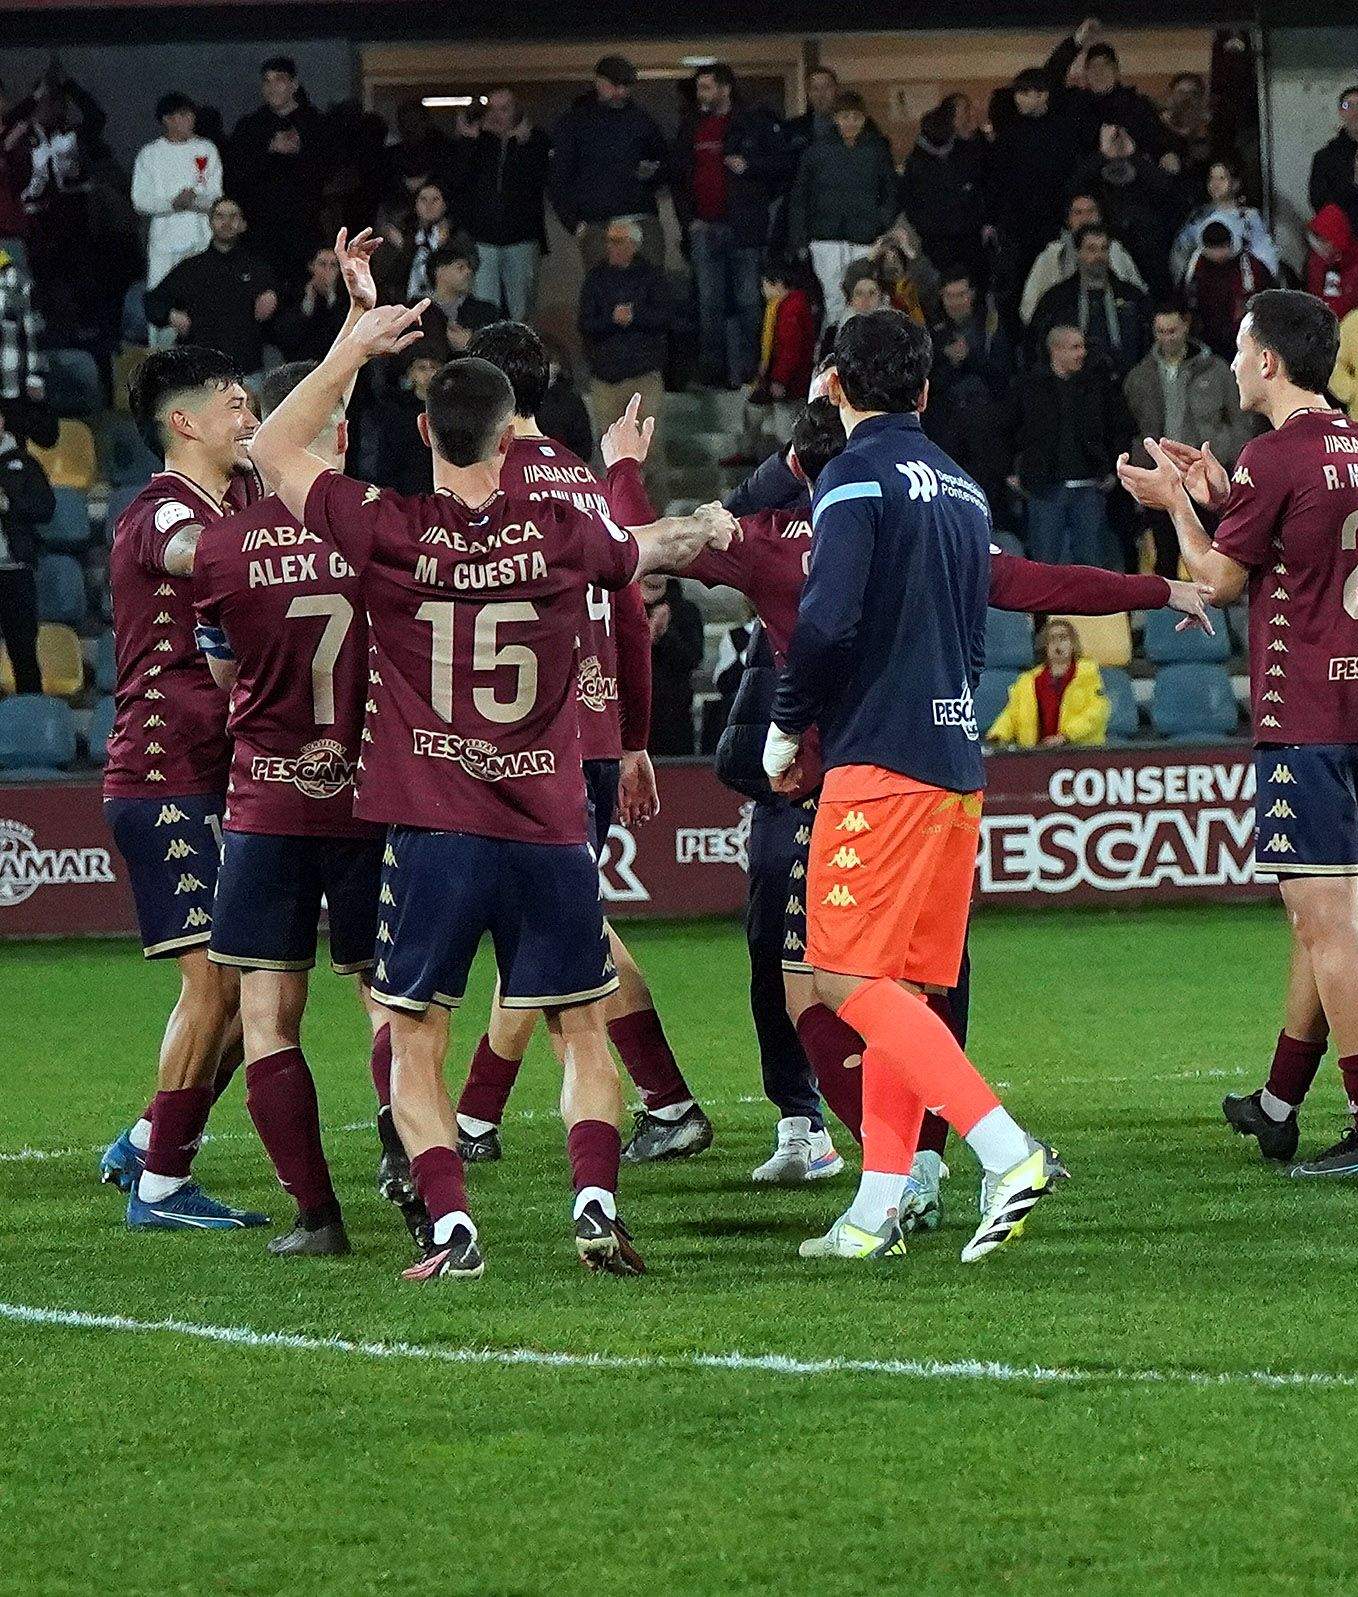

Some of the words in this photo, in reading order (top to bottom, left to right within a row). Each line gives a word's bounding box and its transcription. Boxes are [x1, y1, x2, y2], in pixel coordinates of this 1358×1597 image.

[1322, 464, 1345, 490] R.
[249, 553, 319, 589] ALEX
[414, 555, 445, 588] M.
[453, 551, 548, 590] CUESTA
[285, 593, 354, 725] 7
[414, 601, 540, 724] 15
